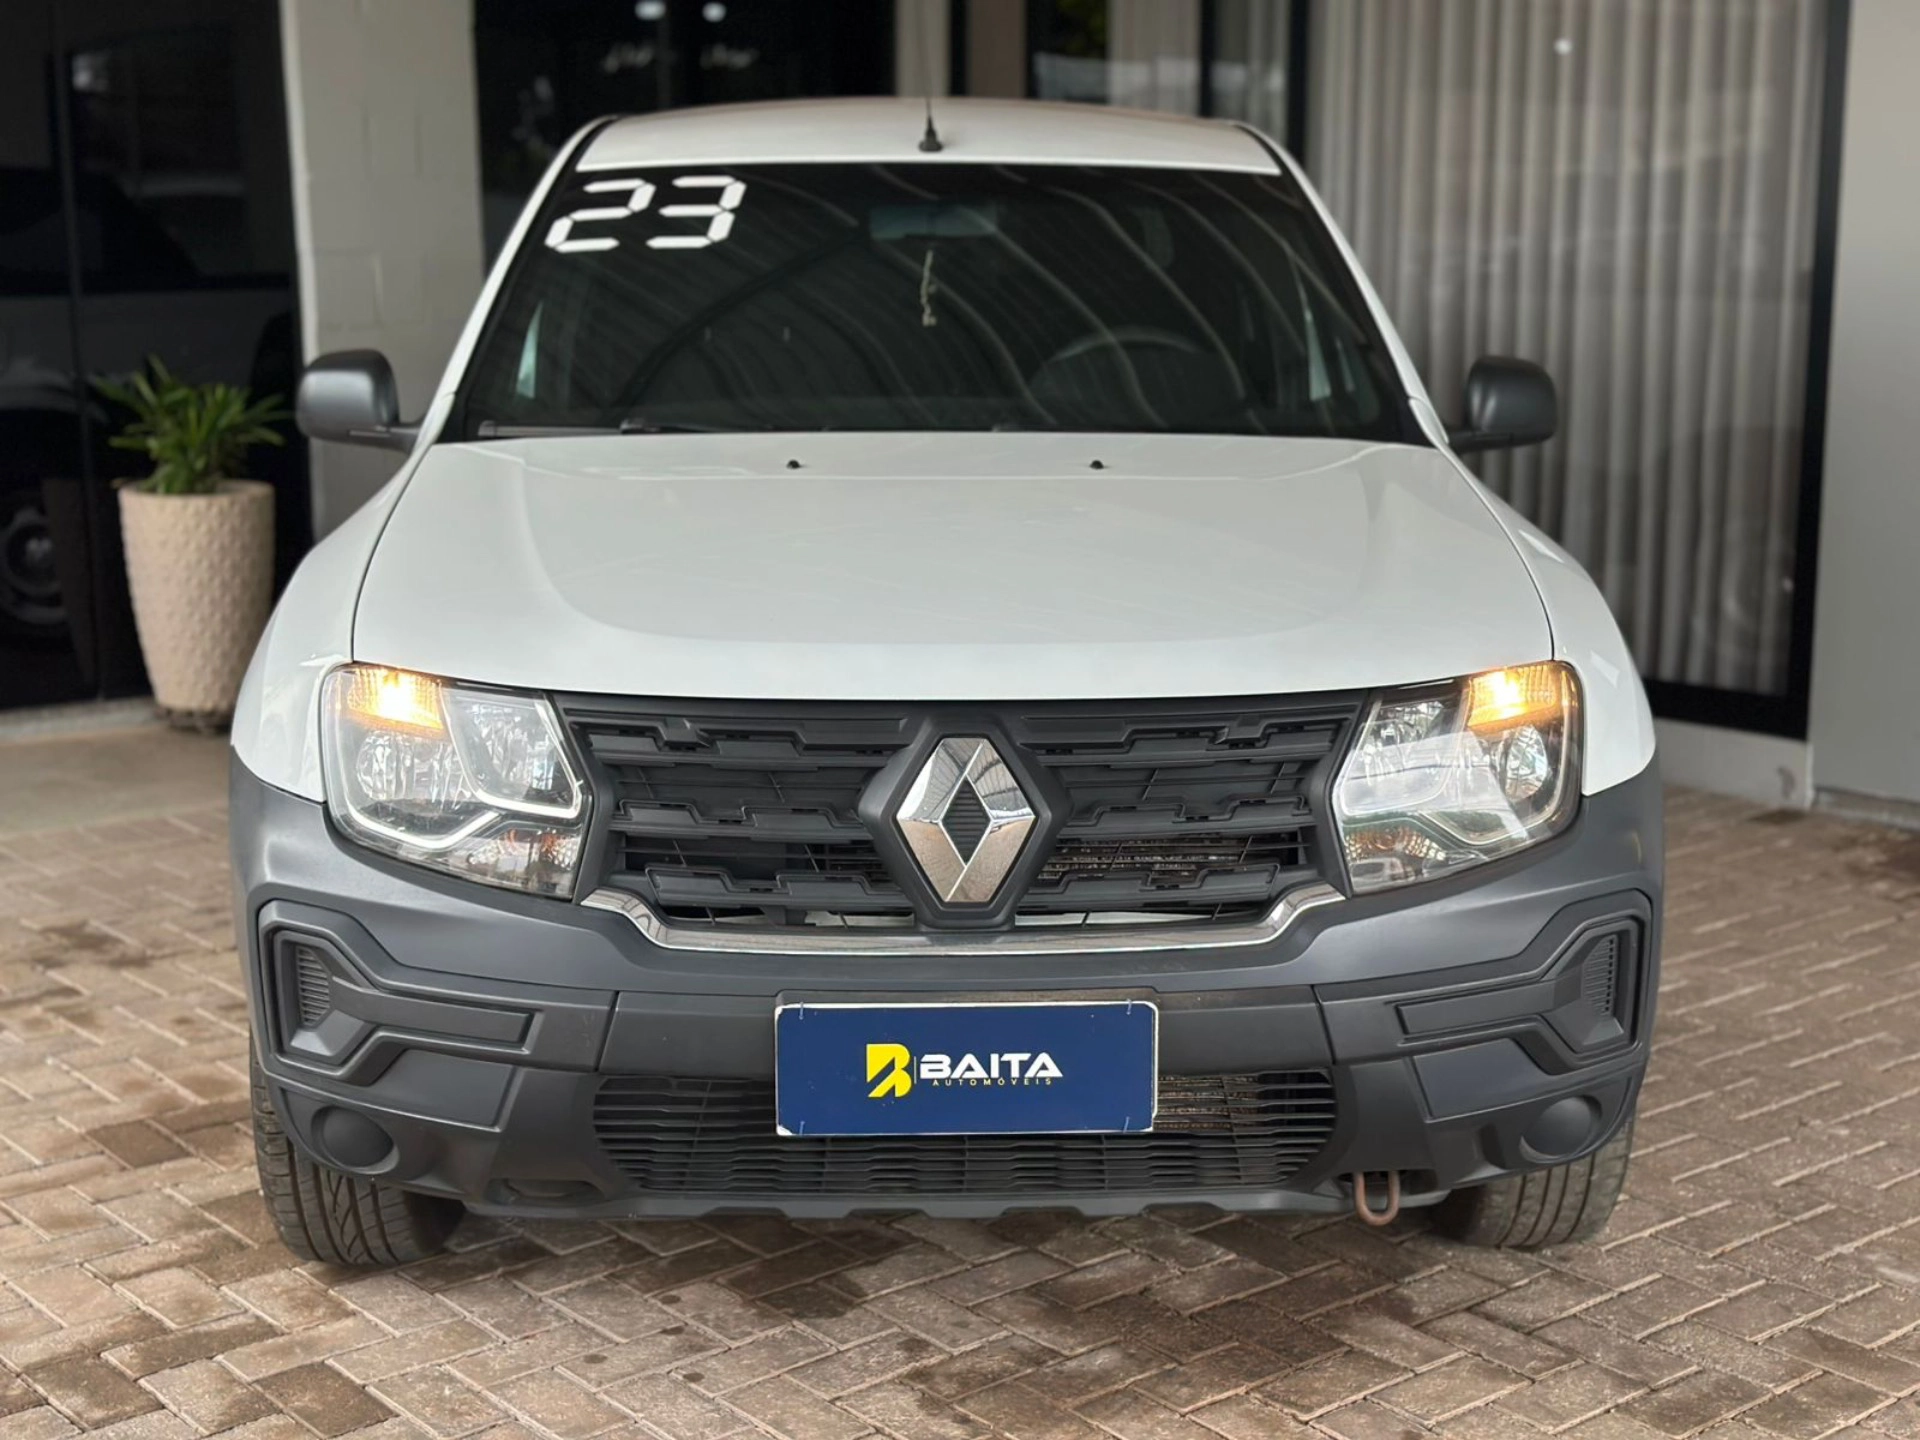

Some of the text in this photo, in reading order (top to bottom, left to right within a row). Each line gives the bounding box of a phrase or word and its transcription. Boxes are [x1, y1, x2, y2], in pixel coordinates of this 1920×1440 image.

[544, 175, 747, 253] 23
[919, 1052, 1064, 1079] BAITA
[931, 1077, 1052, 1087] AUTOMÓVEIS
